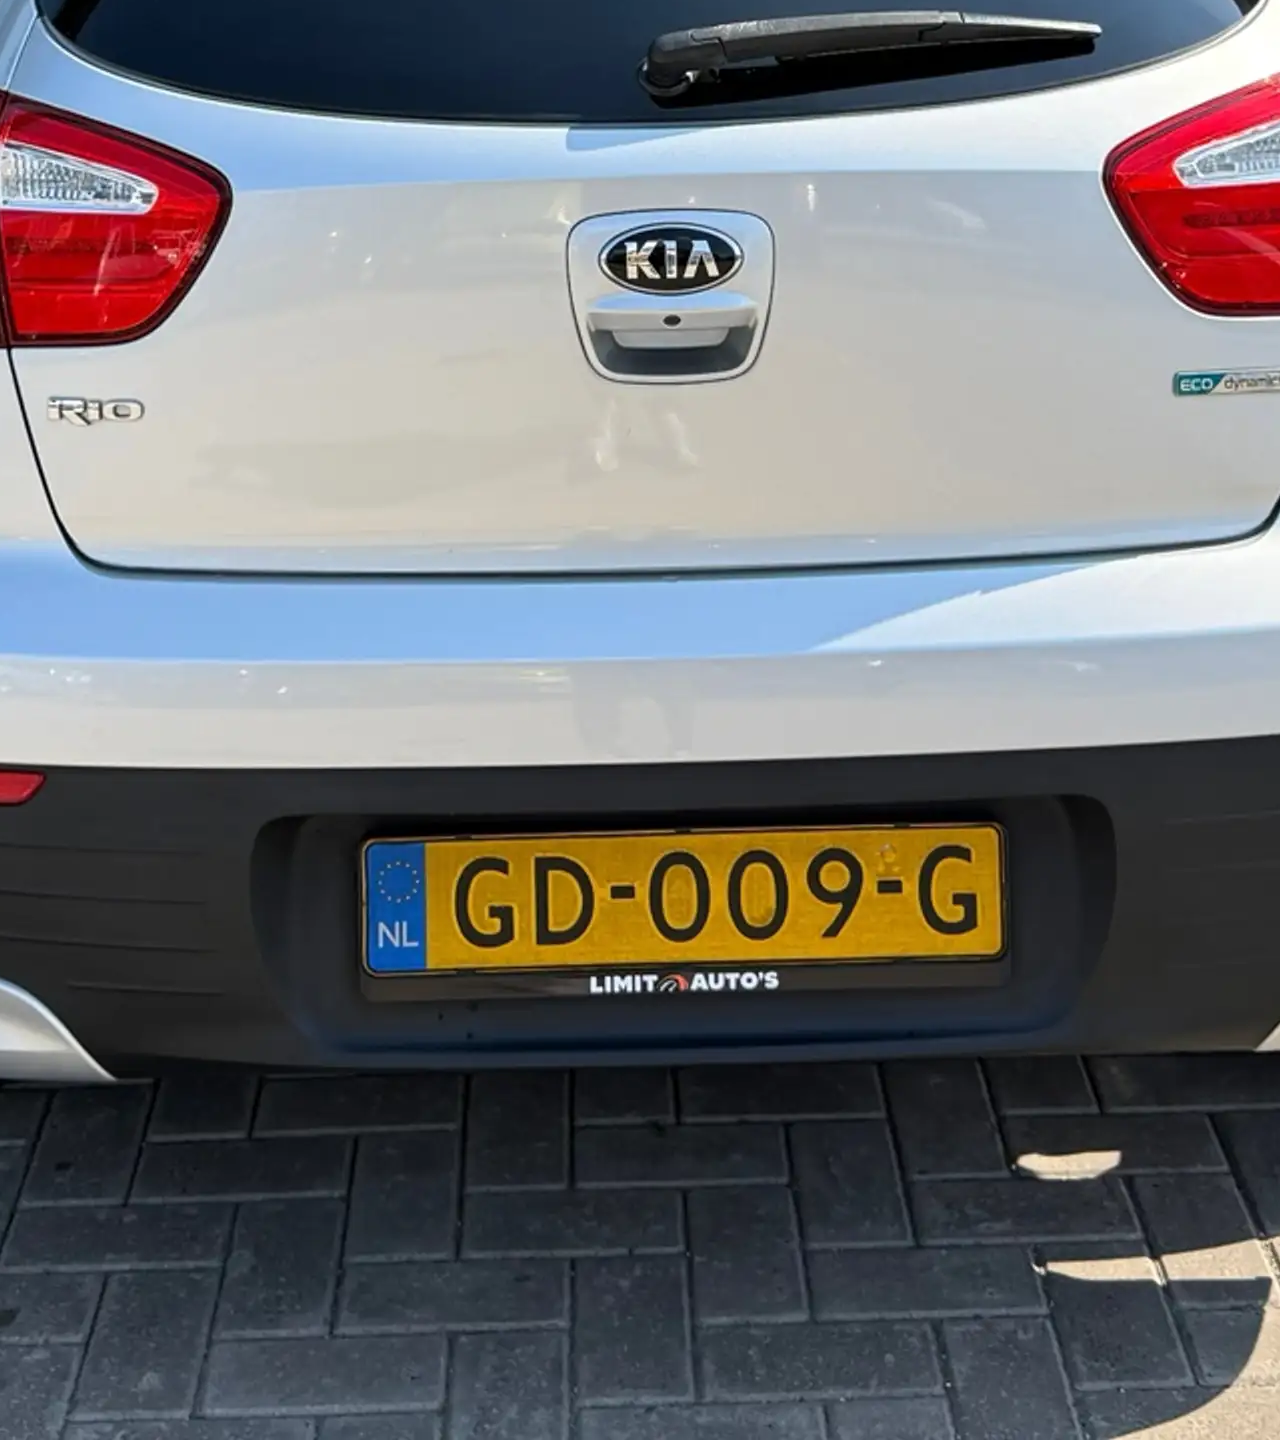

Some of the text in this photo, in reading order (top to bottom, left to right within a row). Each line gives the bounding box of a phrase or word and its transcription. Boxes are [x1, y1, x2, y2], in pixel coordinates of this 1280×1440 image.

[623, 238, 719, 280] KIA
[1179, 377, 1214, 392] ECO
[453, 843, 980, 949] GD-009-G
[376, 922, 420, 950] NL
[589, 970, 780, 994] LIMIT AUTO'S
